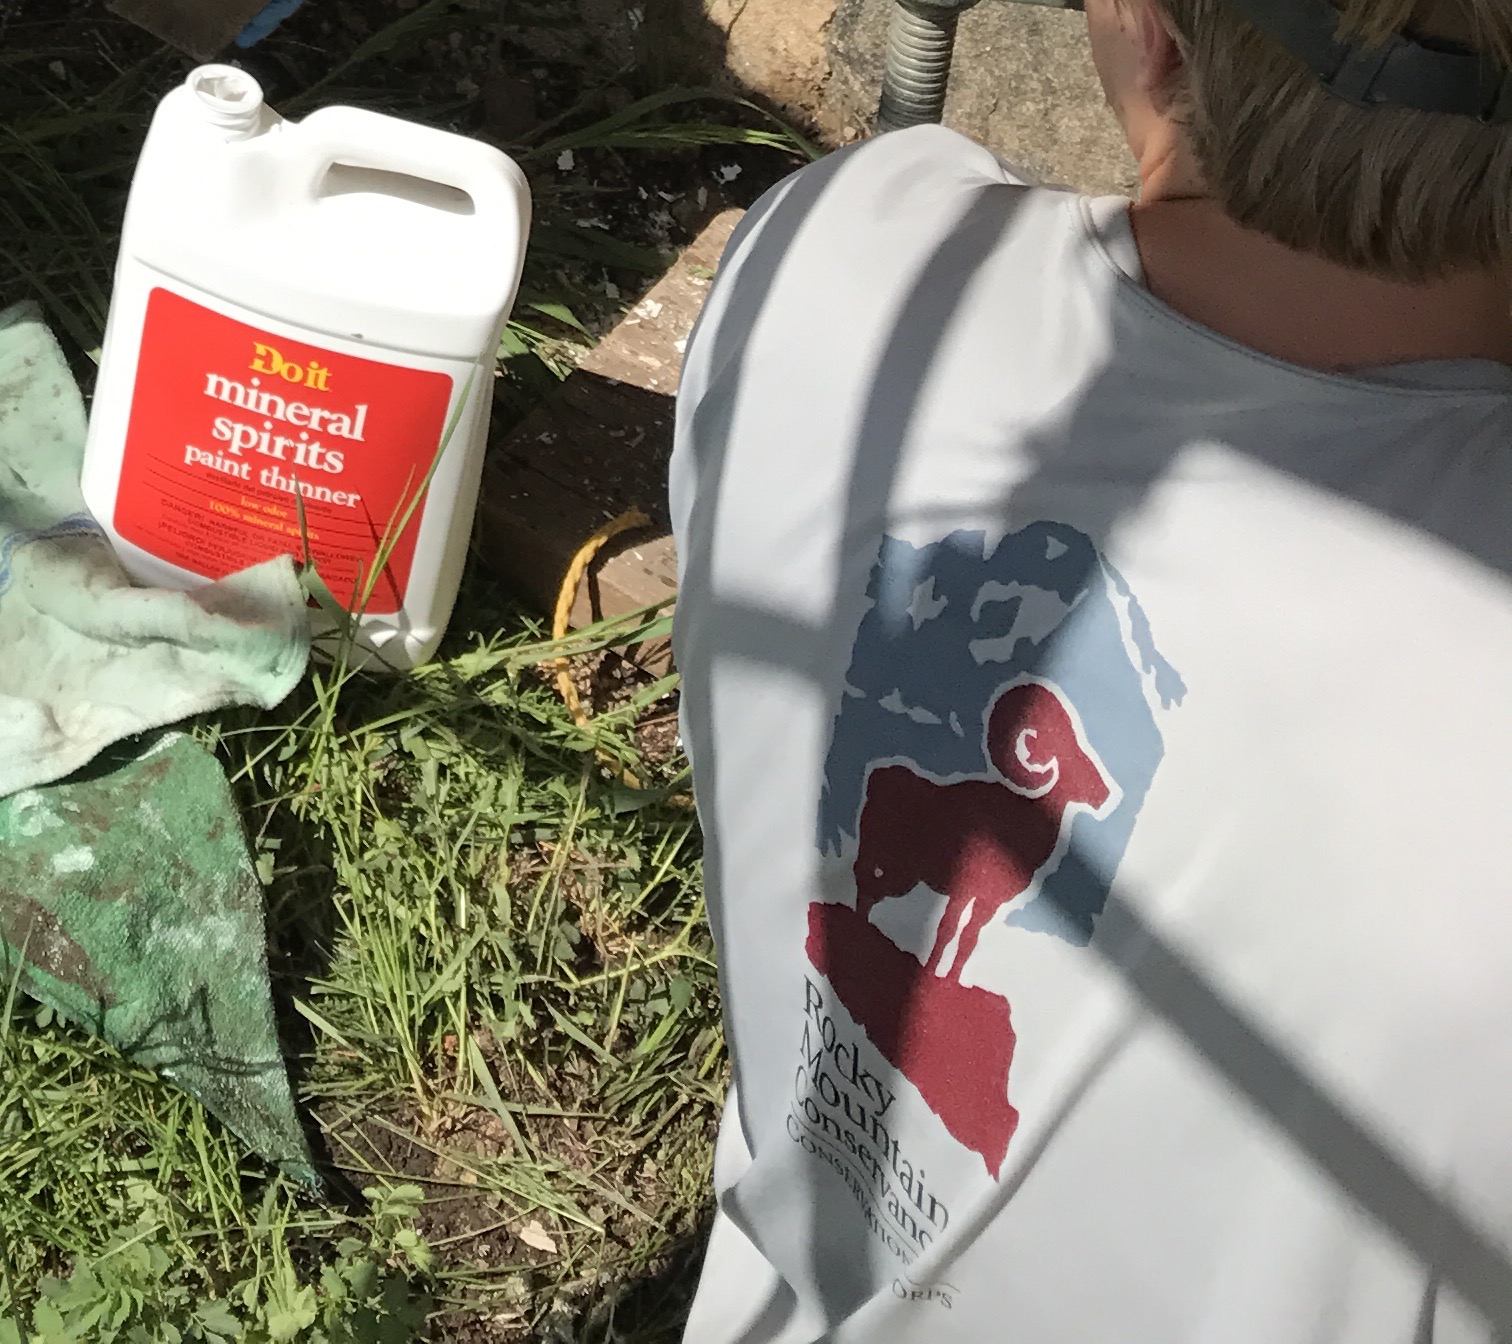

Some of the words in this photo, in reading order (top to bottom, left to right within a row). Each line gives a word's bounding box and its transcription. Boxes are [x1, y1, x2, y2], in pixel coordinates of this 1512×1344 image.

[249, 341, 303, 383] Do
[304, 361, 332, 391] it
[203, 373, 368, 442] mineral
[212, 416, 345, 474] spirits
[184, 444, 252, 480] paint
[260, 466, 361, 508] thinner
[210, 500, 239, 518] 100%
[243, 514, 284, 532] mineral
[241, 496, 259, 510] low
[262, 505, 287, 518] odor
[803, 974, 897, 1117] Rocky
[800, 1020, 948, 1233] Mountain
